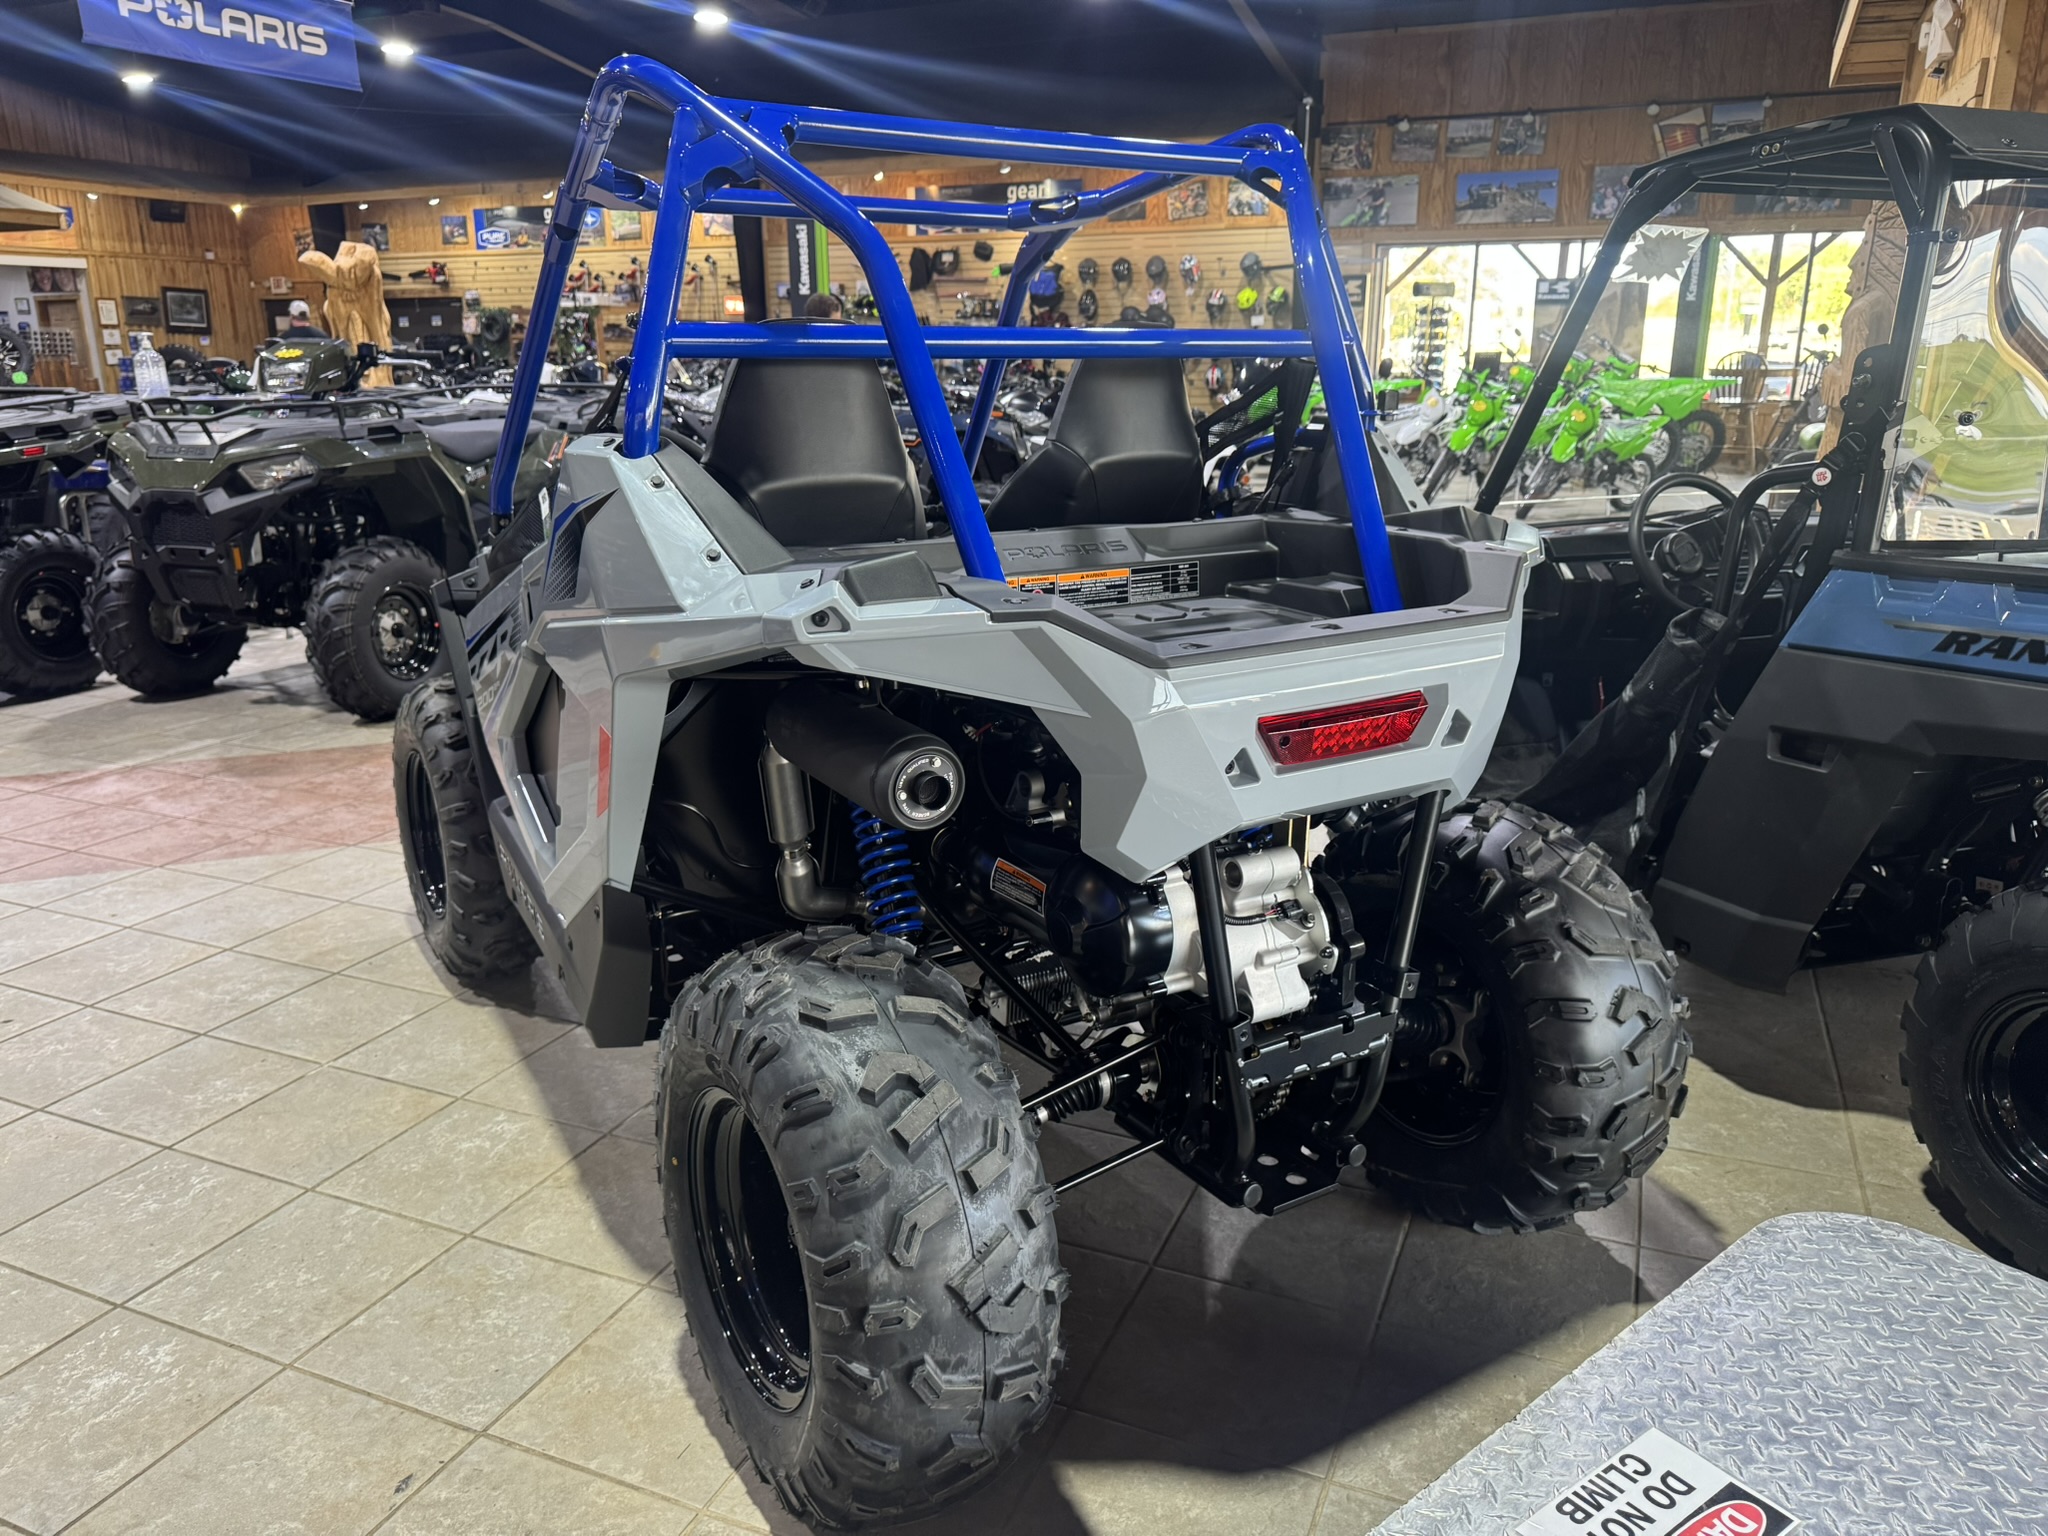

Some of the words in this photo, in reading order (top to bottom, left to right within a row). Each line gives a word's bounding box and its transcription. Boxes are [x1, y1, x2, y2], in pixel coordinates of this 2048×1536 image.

[117, 0, 328, 56] POLARIS
[795, 223, 811, 295] Kawasaki
[1684, 246, 1702, 302] Kawasa
[1001, 539, 1129, 561] POLARIS
[1085, 571, 1108, 579] WARNING
[1554, 1453, 1653, 1525] CLIMB
[1641, 1469, 1698, 1510] DO
[1585, 1500, 1658, 1536] NO
